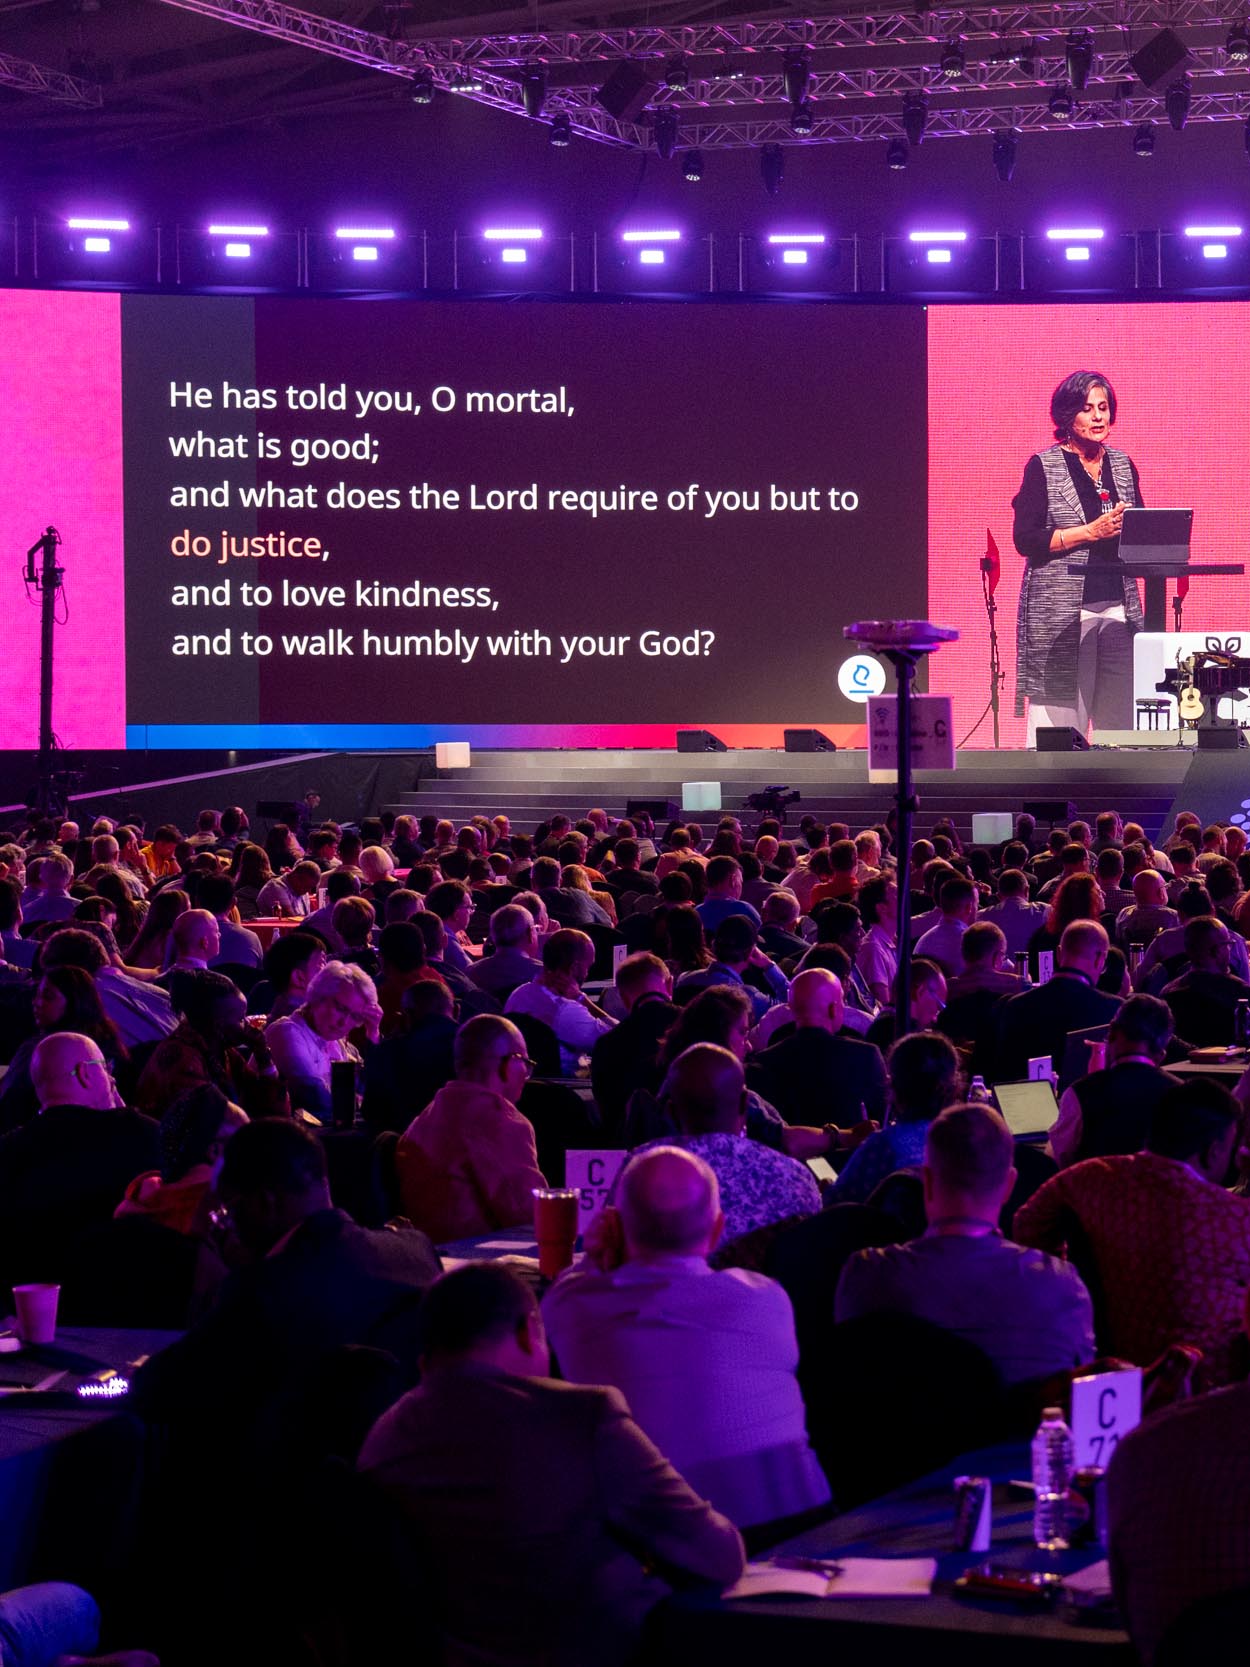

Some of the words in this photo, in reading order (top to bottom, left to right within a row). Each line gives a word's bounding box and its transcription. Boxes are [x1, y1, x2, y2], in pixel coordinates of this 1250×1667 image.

[169, 381, 213, 409] He
[222, 380, 278, 410] has
[285, 382, 347, 411] told
[354, 390, 422, 419] you,
[431, 385, 456, 413] O
[466, 385, 575, 418] mortal,
[168, 429, 249, 459] what
[257, 431, 282, 459] is
[290, 432, 379, 467] good;
[169, 480, 230, 508] and
[238, 480, 319, 509] what
[326, 481, 401, 510] does
[408, 482, 460, 510] the
[470, 483, 538, 511] Lord
[548, 484, 659, 519] require
[667, 483, 700, 511] of
[705, 490, 760, 519] you
[770, 483, 821, 511] but
[827, 487, 859, 512] to
[170, 528, 212, 557] do
[217, 529, 330, 565] justice,
[171, 578, 231, 607] and
[239, 582, 273, 607] to
[282, 578, 346, 607] love
[355, 579, 499, 612] kindness,
[171, 627, 231, 656] and
[240, 631, 274, 656] to
[281, 628, 355, 656] walk
[363, 628, 480, 664] humbly
[486, 628, 552, 657] with
[560, 635, 631, 664] your
[639, 629, 716, 657] God?
[588, 1158, 605, 1186] C
[1098, 1387, 1117, 1429] C
